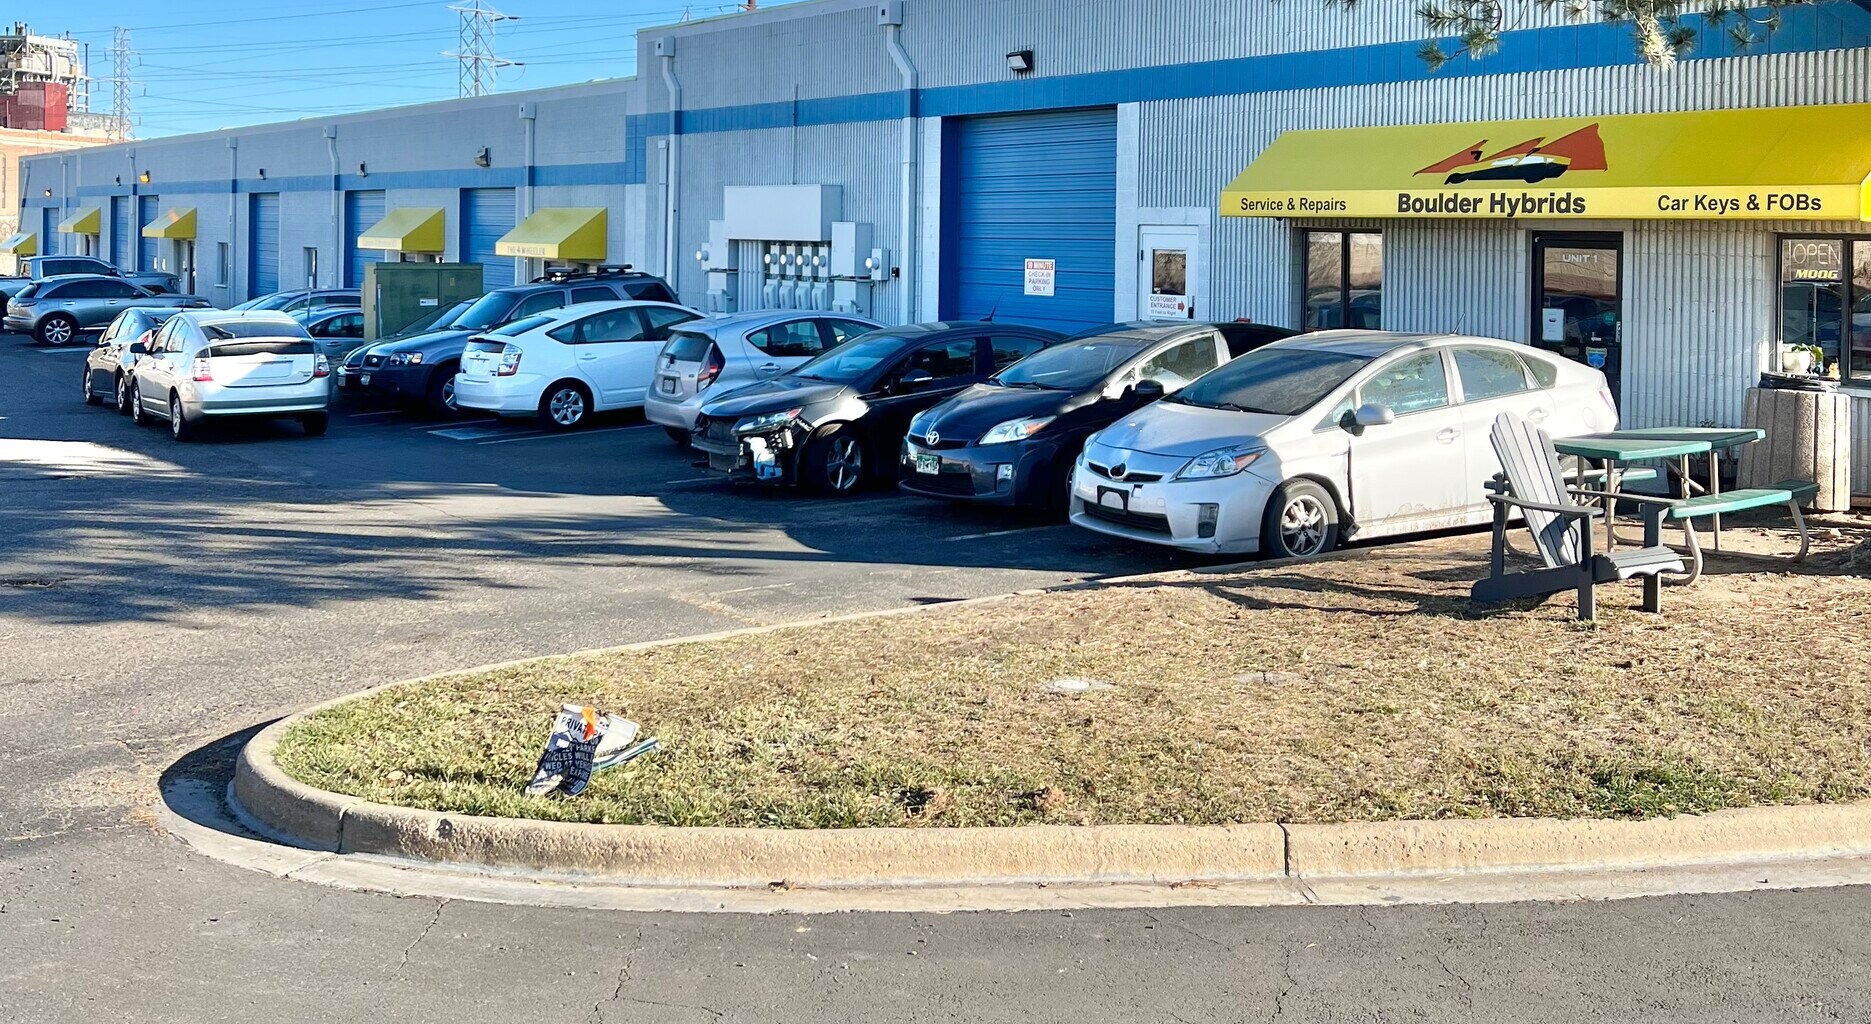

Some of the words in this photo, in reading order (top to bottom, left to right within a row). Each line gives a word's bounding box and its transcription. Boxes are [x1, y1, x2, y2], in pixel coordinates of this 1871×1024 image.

[1240, 197, 1283, 211] Service
[1286, 198, 1296, 211] &
[1299, 197, 1346, 214] Repairs
[1397, 192, 1483, 213] Boulder
[1489, 192, 1586, 217] Hybrids
[1657, 194, 1689, 211] Car
[1694, 194, 1740, 215] Keys
[1746, 193, 1760, 211] &
[1767, 193, 1822, 211] FOBs
[1562, 254, 1590, 263] UNIT
[1592, 254, 1598, 263] 1
[1792, 243, 1840, 265] OPEN
[1034, 262, 1053, 270] MINUTE
[1795, 269, 1839, 279] MOOG
[561, 716, 588, 735] PRIVAT
[545, 761, 562, 770] WED
